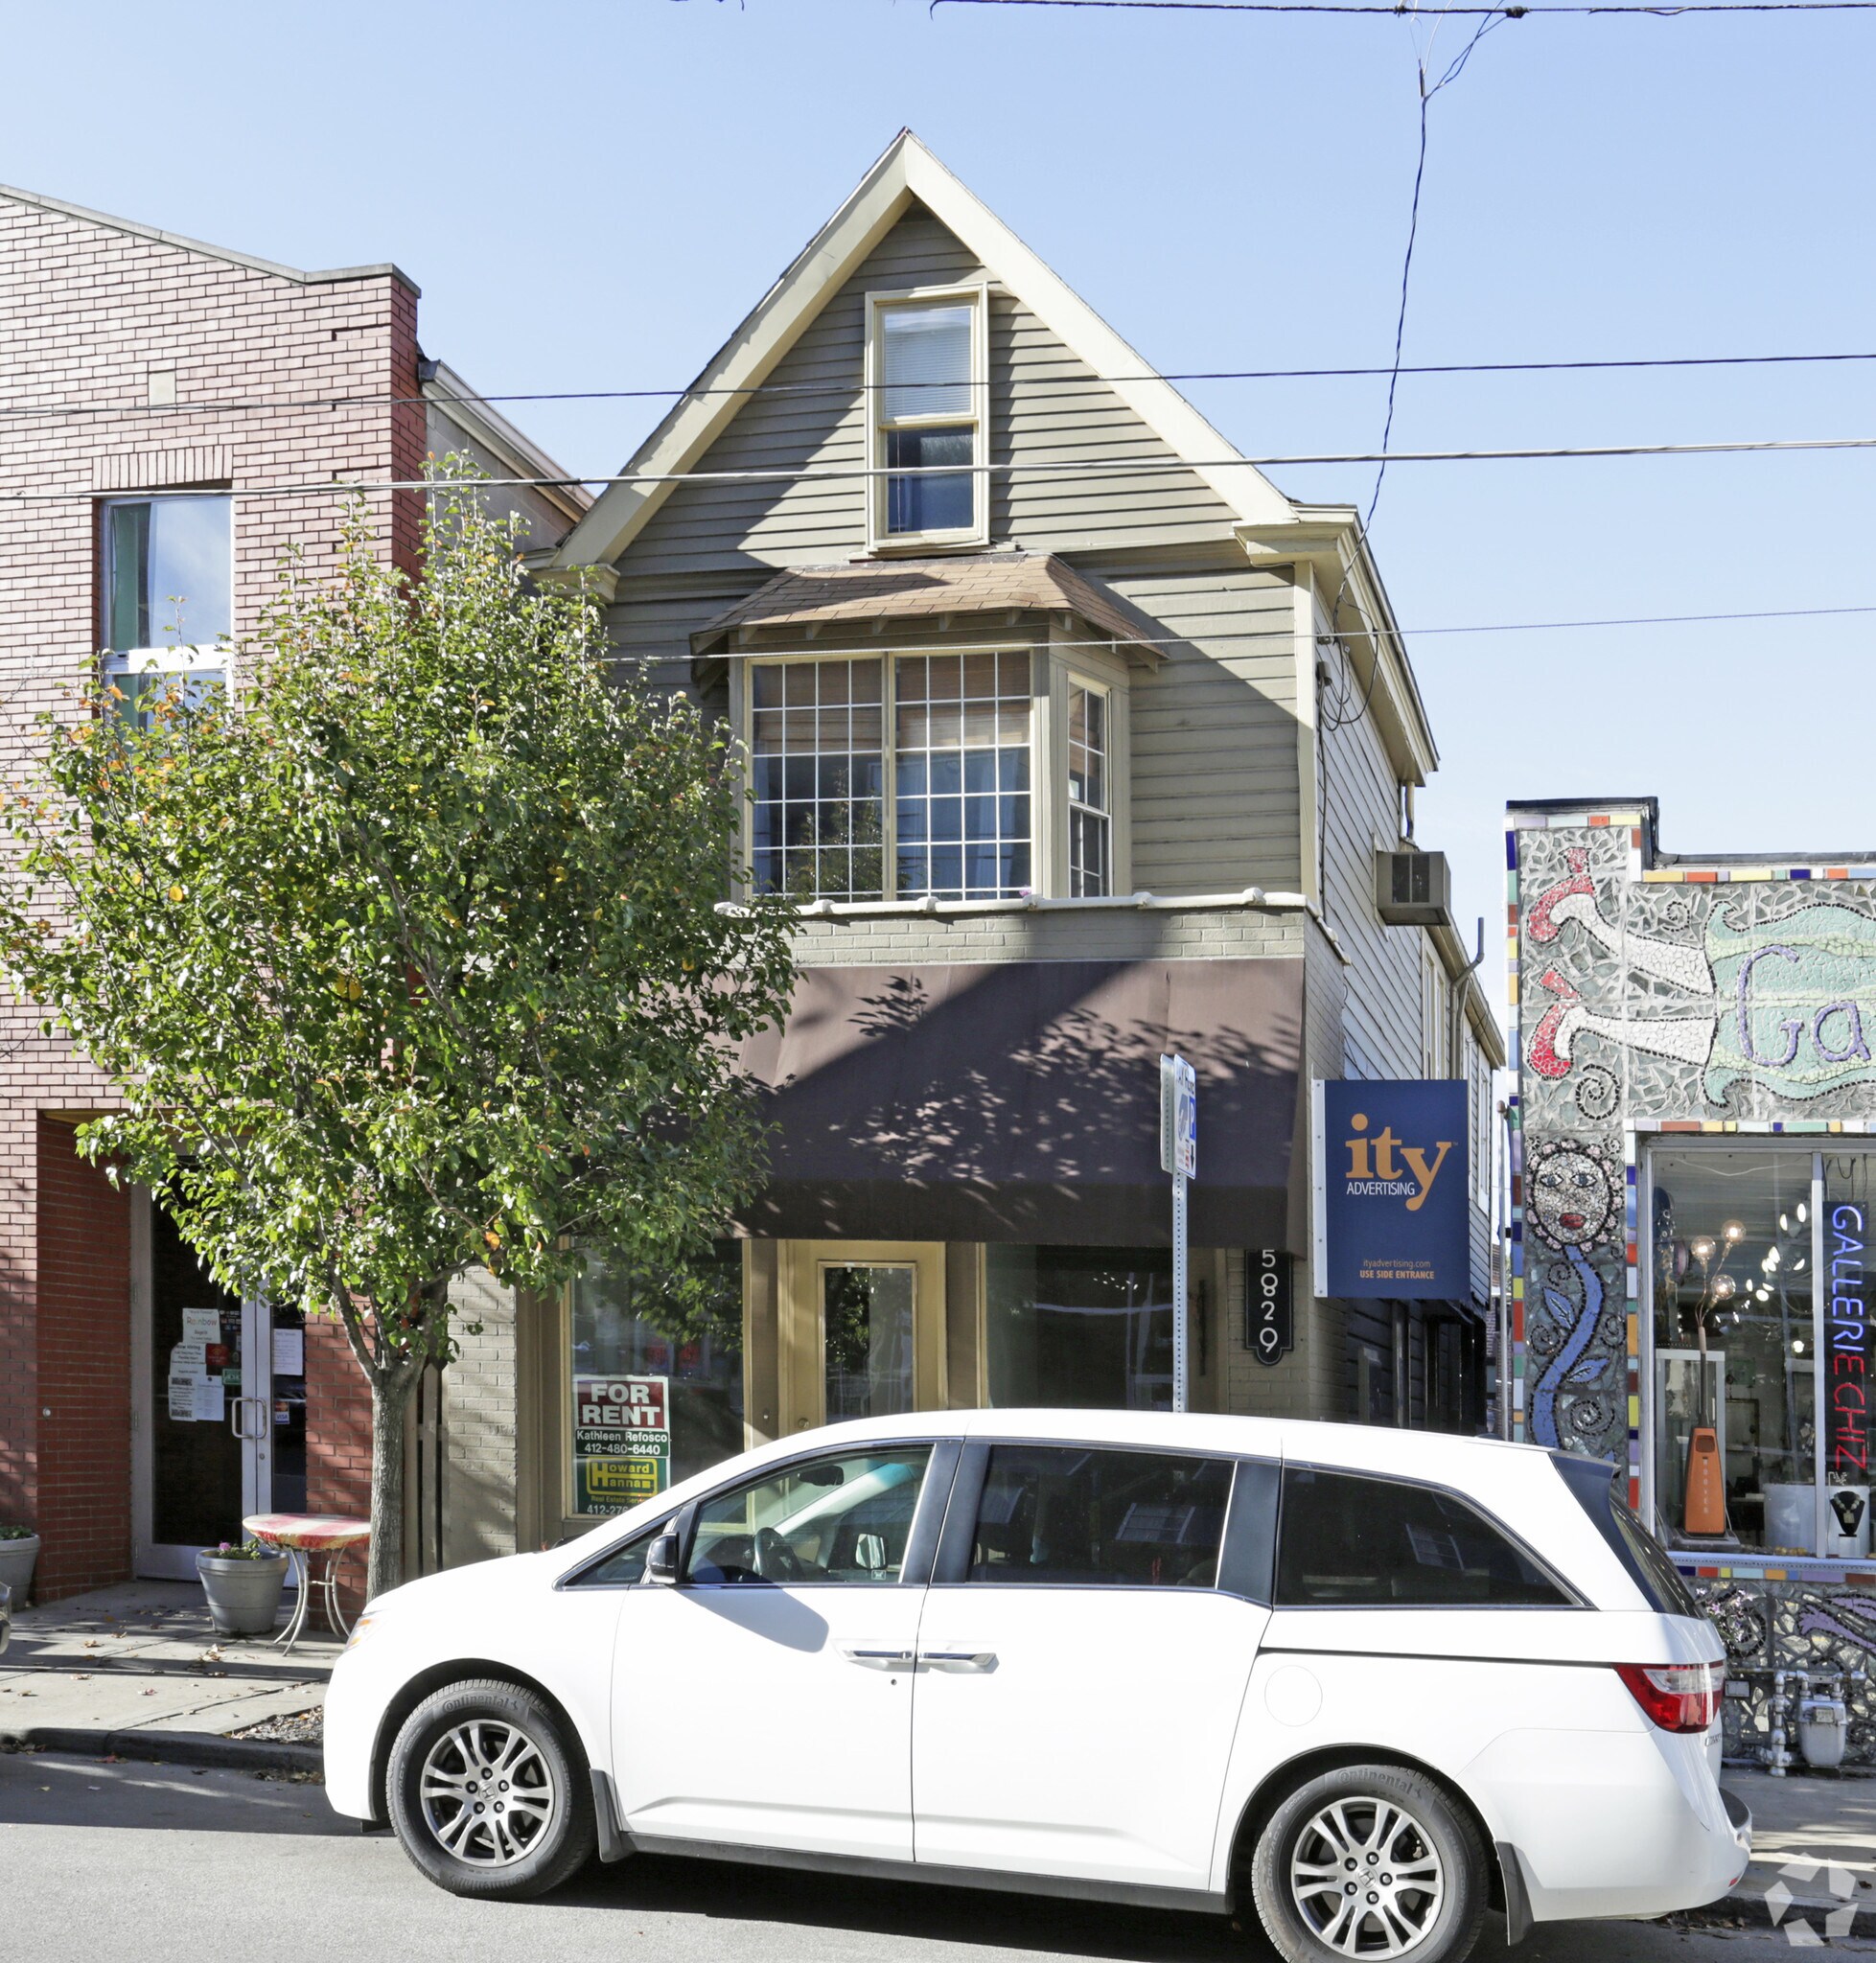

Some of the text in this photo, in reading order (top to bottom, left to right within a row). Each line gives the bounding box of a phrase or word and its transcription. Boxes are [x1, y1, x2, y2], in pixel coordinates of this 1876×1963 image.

[1345, 1113, 1452, 1212] ity
[1346, 1182, 1415, 1195] ADVERTISING
[1363, 1258, 1431, 1270] ityadvertising.com
[1359, 1270, 1435, 1280] USE SIDE ENTRANCE
[1259, 1249, 1279, 1353] 5829
[1832, 1205, 1866, 1470] GALLERIE CHIZ
[591, 1383, 650, 1404] FOR
[582, 1404, 660, 1426] RENT
[576, 1431, 667, 1443] Kathleen Refosco
[584, 1443, 660, 1455] 412-480-6440
[591, 1463, 650, 1478] Howard
